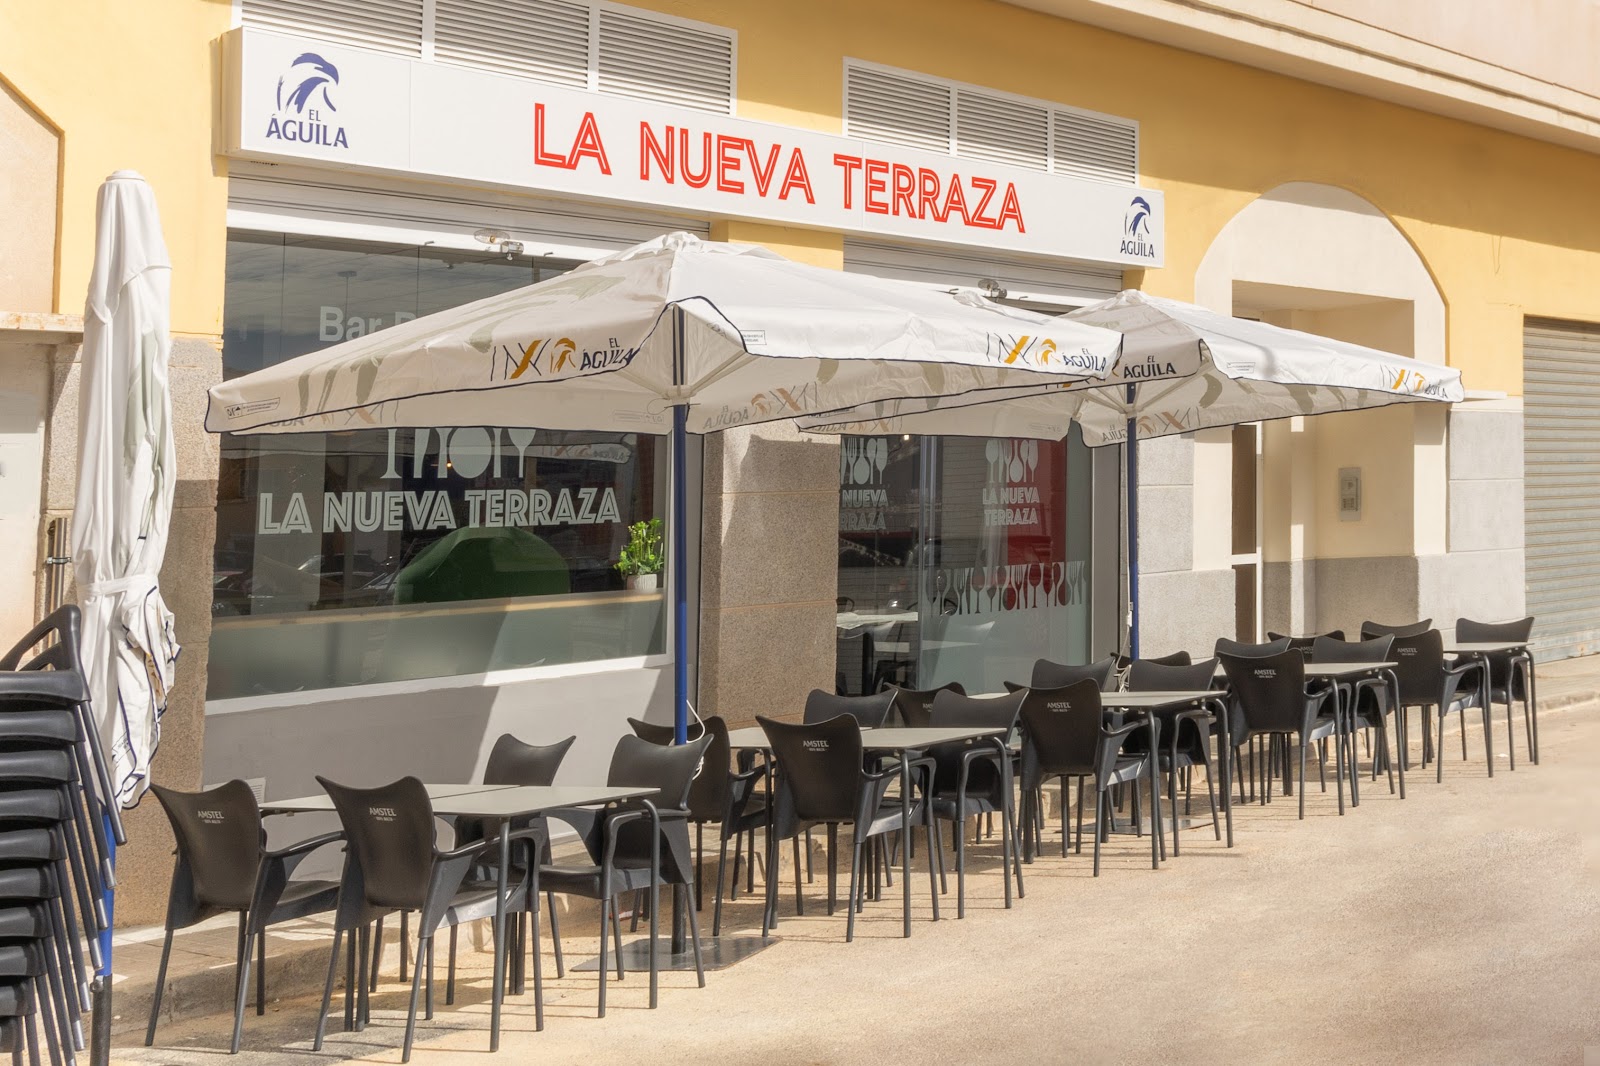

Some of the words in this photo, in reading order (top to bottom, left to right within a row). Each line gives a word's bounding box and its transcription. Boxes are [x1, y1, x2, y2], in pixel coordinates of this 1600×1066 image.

[308, 109, 321, 122] EL
[265, 113, 349, 149] ÁGUILA
[534, 102, 613, 176] LA
[639, 120, 816, 205] NUEVA
[833, 153, 1026, 234] TERRAZA
[1137, 233, 1144, 242] EL
[319, 306, 382, 341] Bar
[608, 337, 621, 349] EL
[1081, 347, 1091, 356] EL
[1146, 355, 1156, 364] EL
[1123, 362, 1178, 380] ÁGUILA
[842, 489, 889, 508] NUEVA
[982, 487, 999, 505] LA
[1000, 486, 1040, 505] NUEVA
[258, 492, 313, 534] LA
[323, 490, 457, 533] NUEVA
[464, 487, 621, 529] TERRAZA
[984, 507, 1039, 527] TERRAZA
[840, 511, 887, 531] RRAZA
[803, 740, 830, 748] AMSTEL
[197, 810, 225, 819] AMSTEL
[369, 807, 397, 817] AMSTEL
